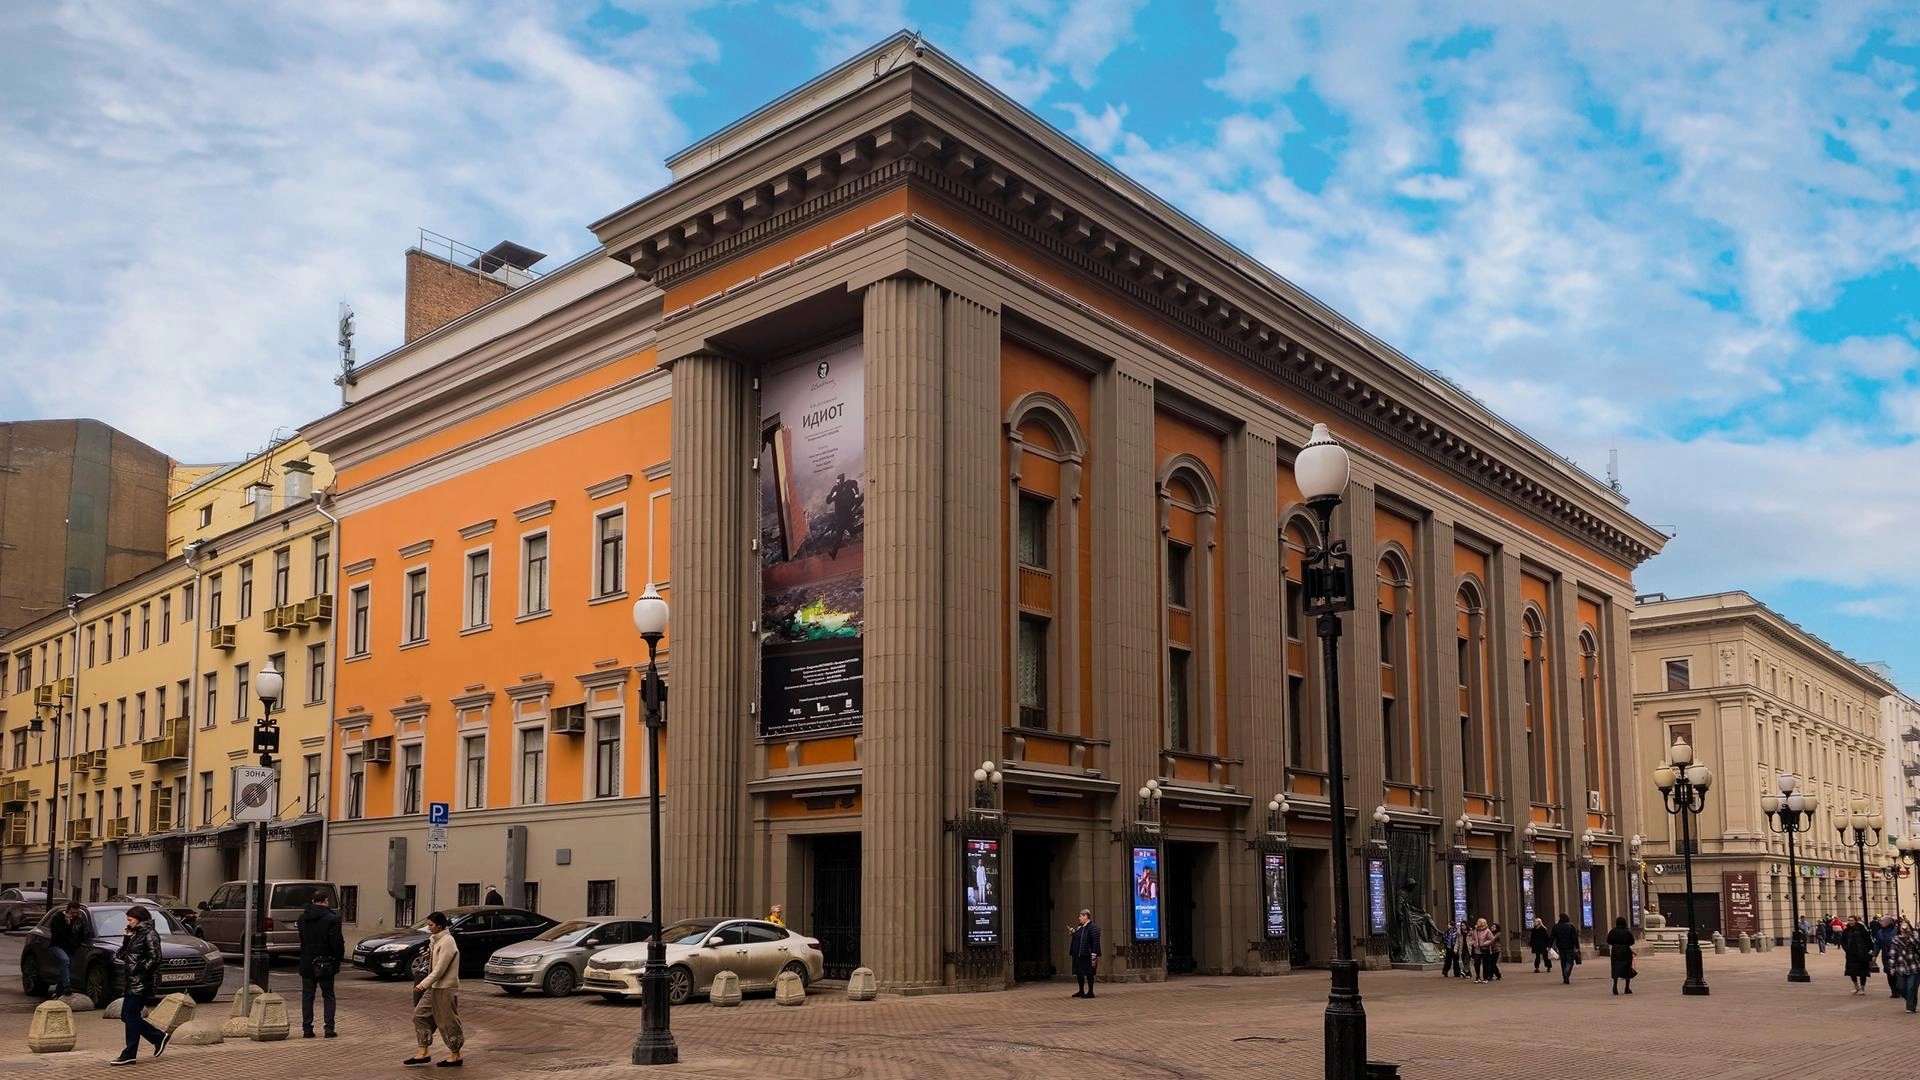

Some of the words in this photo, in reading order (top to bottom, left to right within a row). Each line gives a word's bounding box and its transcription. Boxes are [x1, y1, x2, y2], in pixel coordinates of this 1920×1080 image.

[802, 402, 844, 429] ИДИОТ
[245, 770, 266, 778] ЗОНА
[432, 804, 444, 822] P
